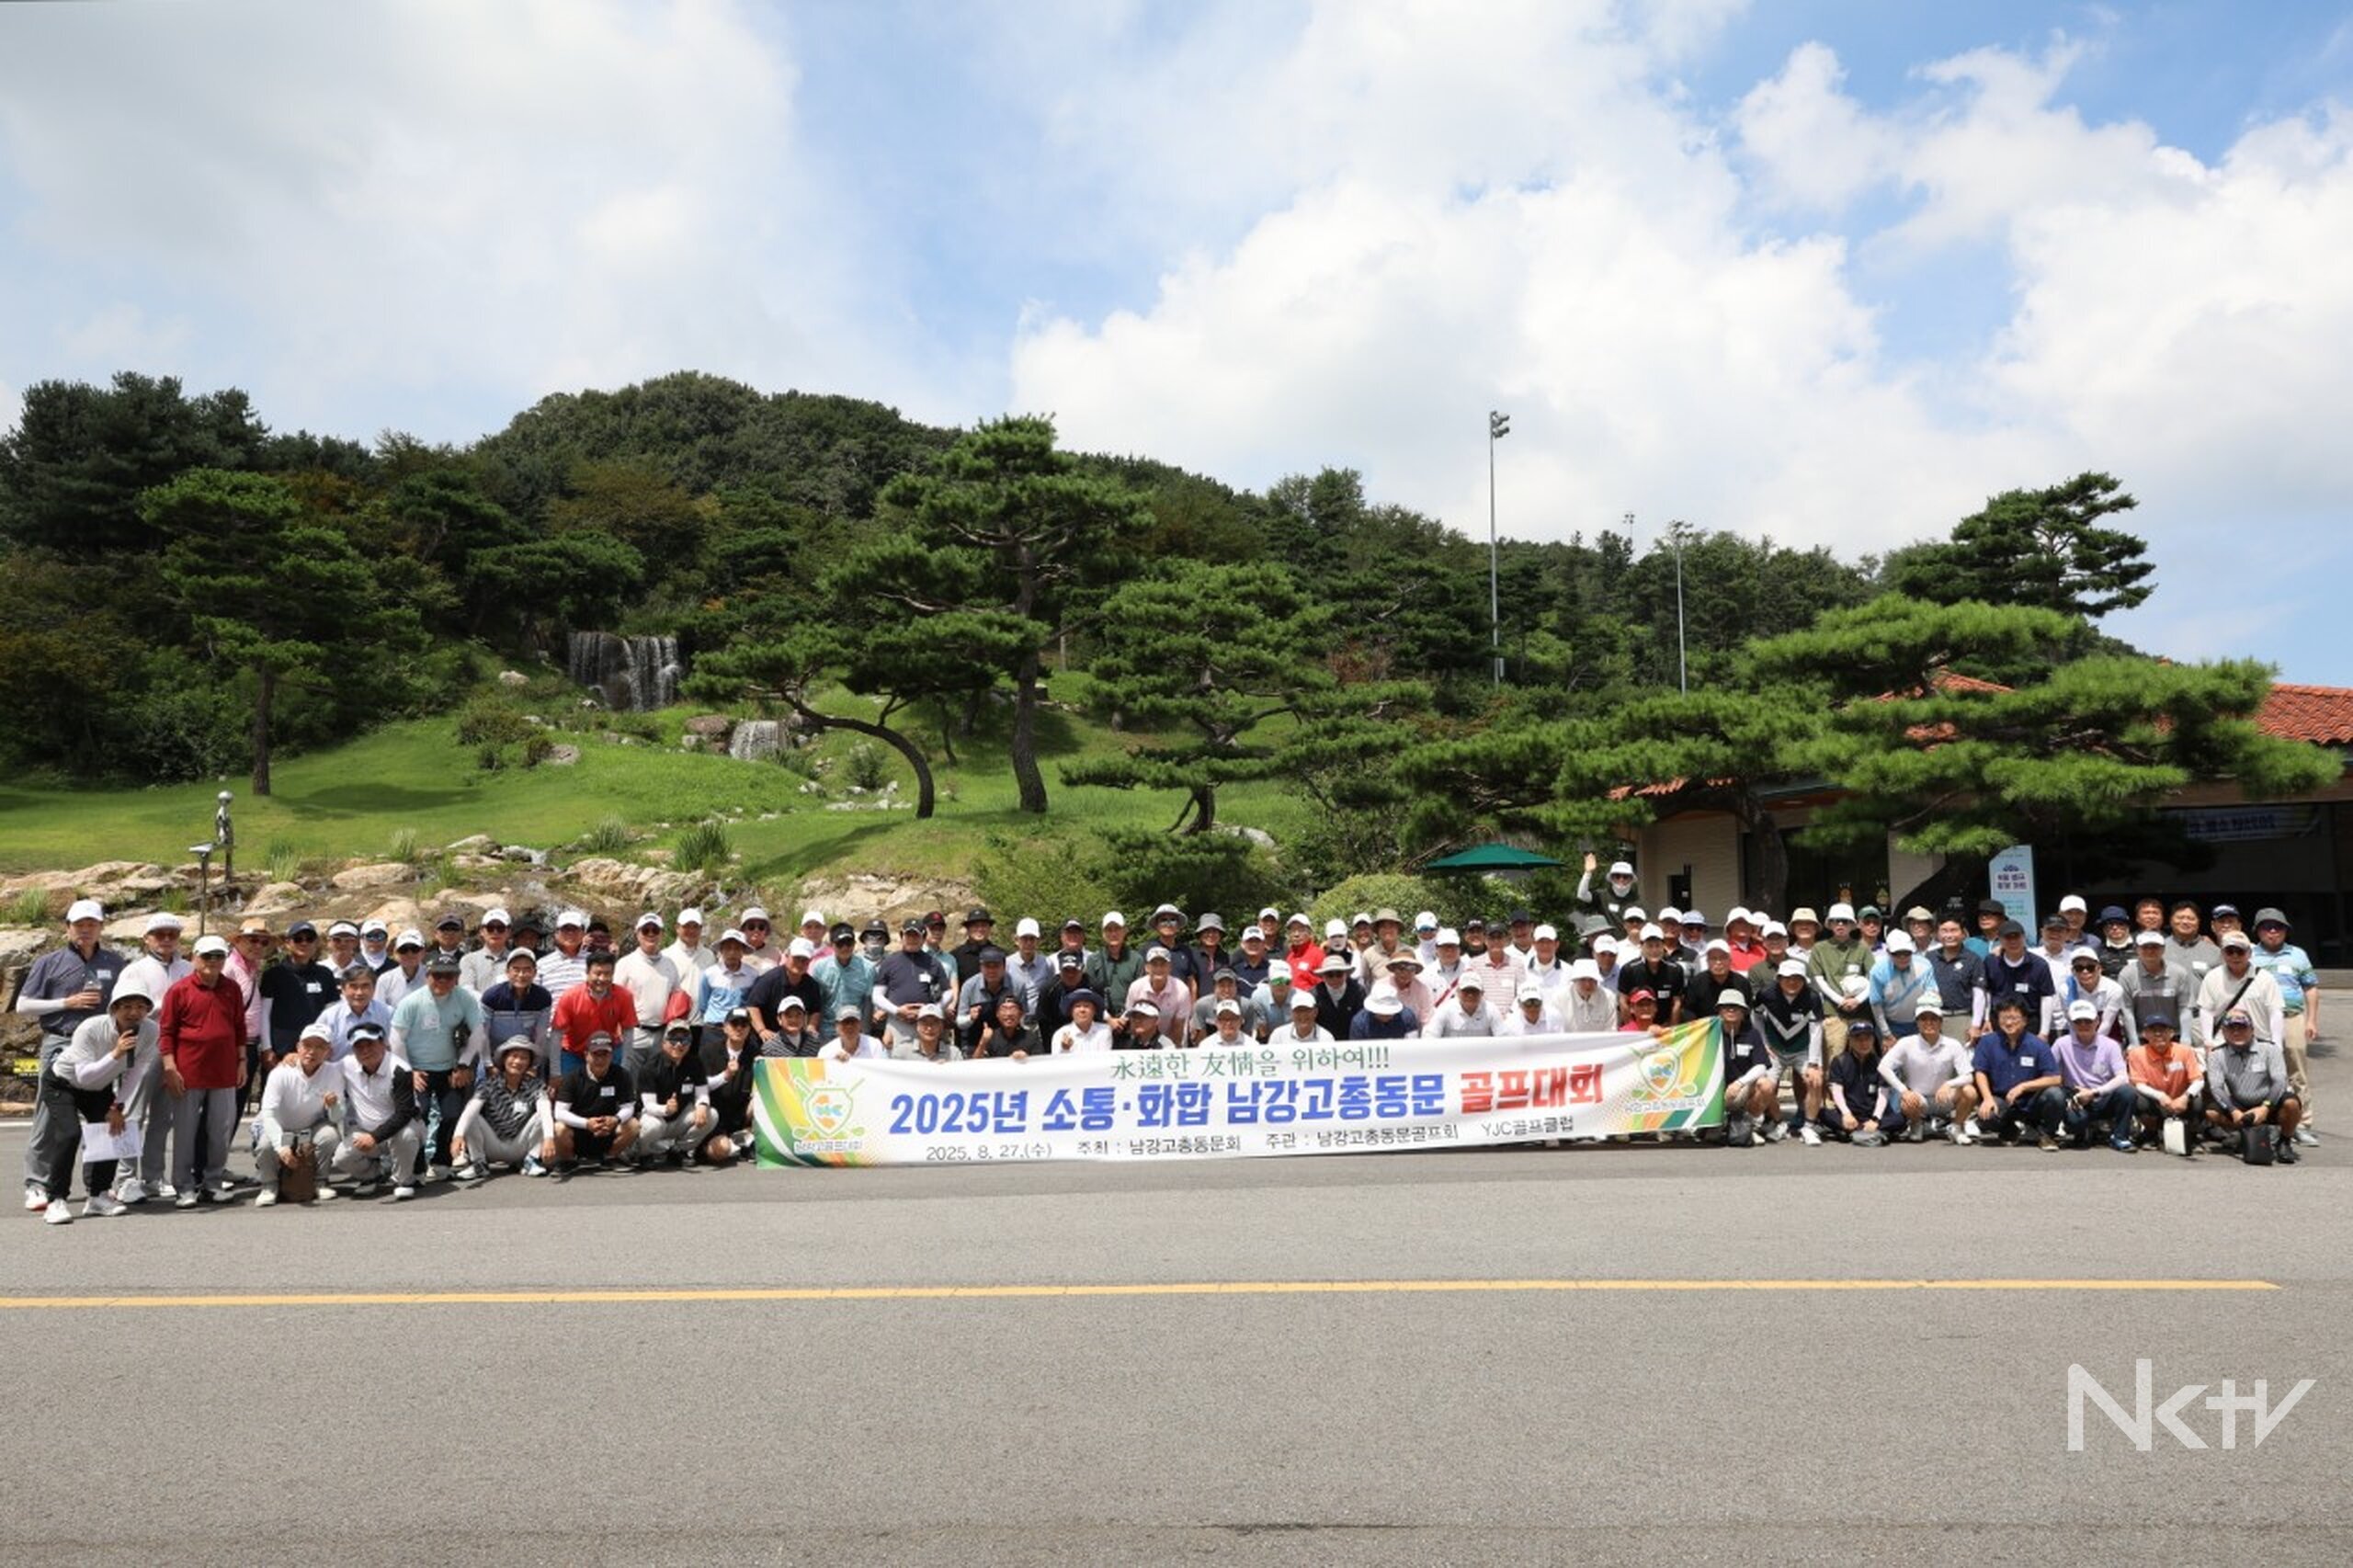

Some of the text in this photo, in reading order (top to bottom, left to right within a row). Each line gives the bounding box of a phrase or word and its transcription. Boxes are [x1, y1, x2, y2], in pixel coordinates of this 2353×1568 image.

[1110, 1046, 1390, 1080] 永遠한 友情을 위하여!!!
[889, 1090, 1029, 1134] 2025년
[1227, 1074, 1445, 1124] 남강고총동문
[1461, 1063, 1604, 1114] 골프대회
[926, 1146, 972, 1161] 2025.
[1130, 1135, 1242, 1155] 남강고총동문회
[1266, 1131, 1297, 1149] 주관
[1317, 1124, 1459, 1147] 남강고총동문골프회
[1481, 1115, 1574, 1137] YJC골프클럽
